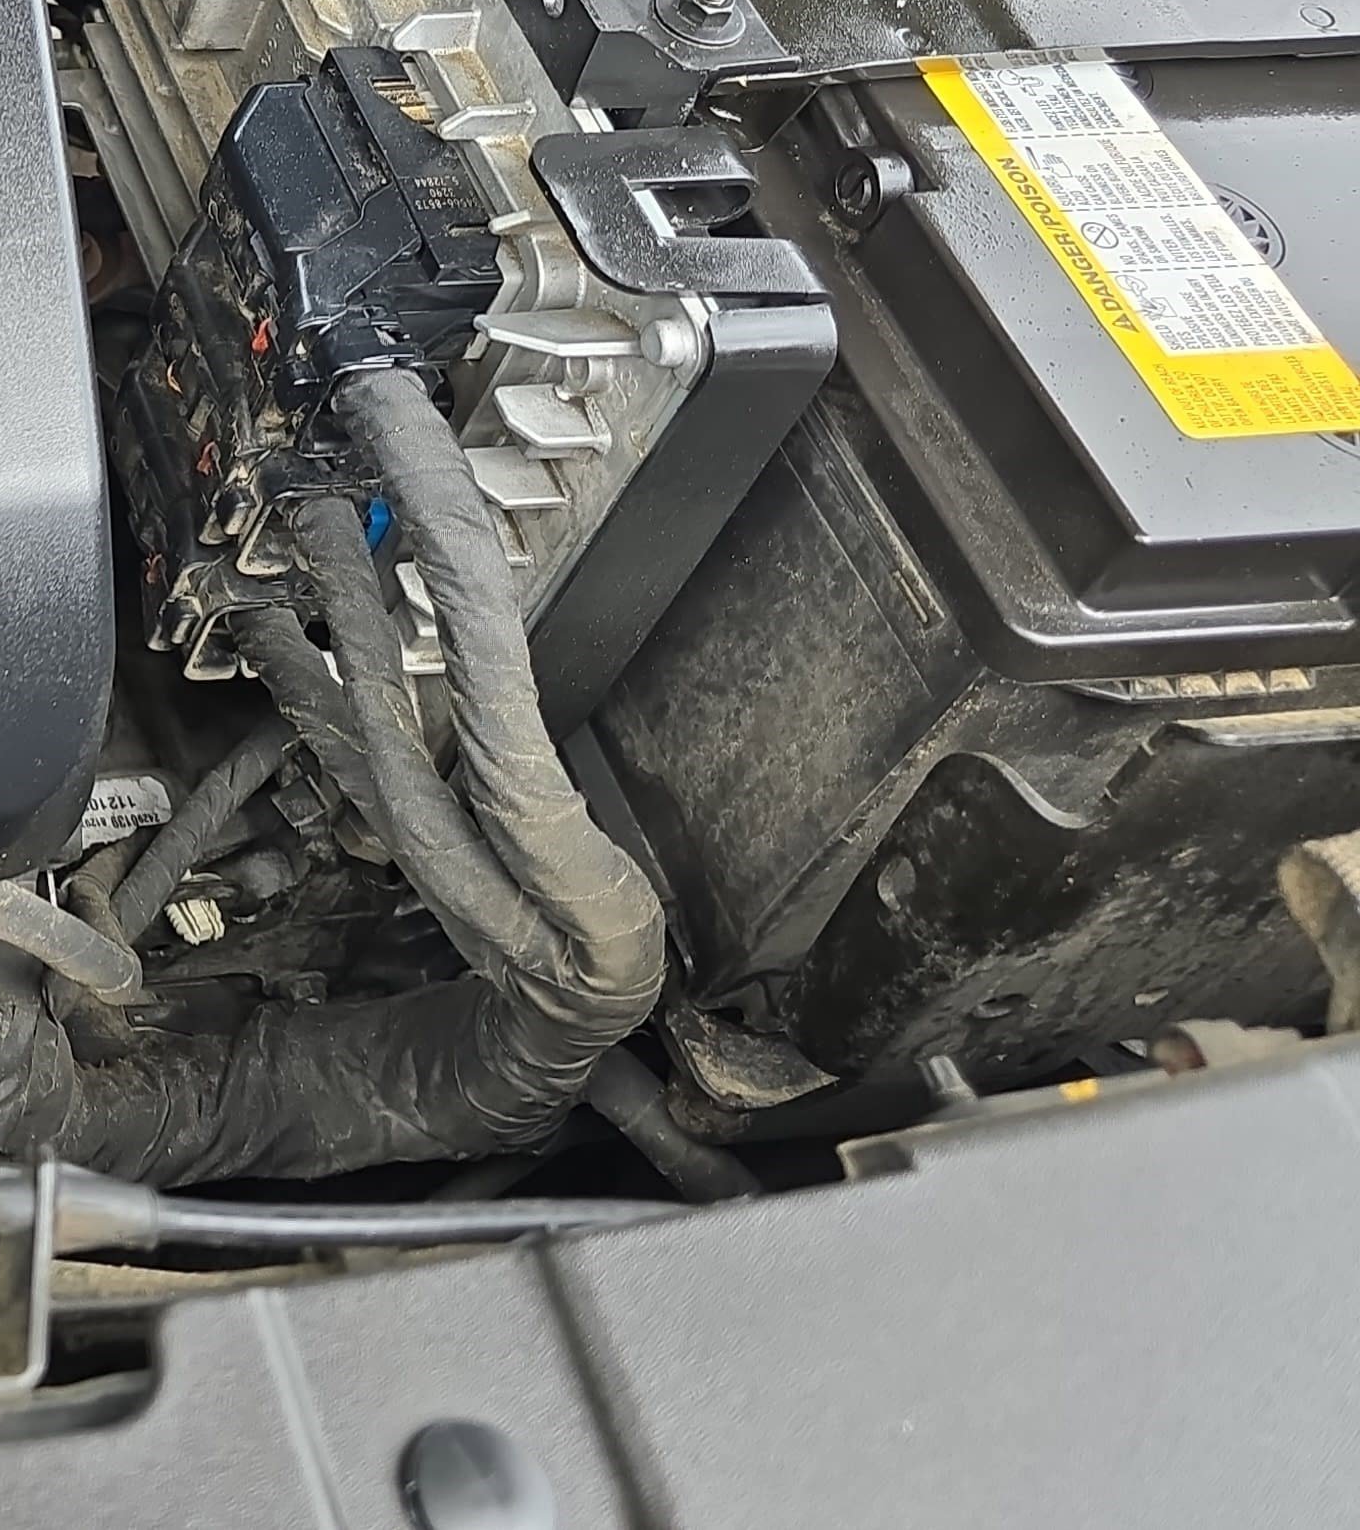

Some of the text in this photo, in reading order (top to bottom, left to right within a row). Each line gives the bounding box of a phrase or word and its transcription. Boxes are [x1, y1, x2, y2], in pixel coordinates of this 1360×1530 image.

[1076, 98, 1111, 128] CONSULTEZ
[1095, 138, 1158, 202] L'ACIDE SULFURIQUE
[1147, 161, 1166, 171] DES
[1152, 149, 1181, 170] GRAVES
[1040, 174, 1076, 206] SULFURIC
[1067, 190, 1092, 205] ACID
[1073, 175, 1107, 205] CAN CAUSE
[1081, 164, 1122, 204] BLINDNESS OR
[1096, 162, 1138, 203] SEVERE BURNS
[1151, 187, 1173, 201] PEUT
[994, 157, 1126, 310] DANGER/POISON
[1104, 213, 1133, 237] FLAMES
[1118, 255, 1137, 264] NO
[1130, 226, 1169, 263] OR SMOKING
[1156, 238, 1190, 262] ÉVITER
[1186, 251, 1206, 261] LES
[1201, 250, 1221, 261] LES
[1202, 230, 1237, 260] DE FUMER
[1177, 291, 1232, 347] GASES CAN CAUSE
[1185, 278, 1248, 346] BLINDNESS OR INJURY
[1200, 273, 1268, 346] PROTÉGEZ LES YEUX
[1227, 285, 1284, 344] LES GAZ EXPLOSIFS
[1237, 277, 1299, 344] PEUVENT BLESSER OU
[1263, 289, 1316, 343] RENDRE AVEUGLE
[1153, 324, 1185, 350] SHIELD
[1174, 331, 1201, 349] EYES
[1179, 316, 1216, 348] EXPLOSIVE
[1171, 370, 1190, 380] DO
[1189, 373, 1208, 385] NOT
[1254, 379, 1273, 390] DES
[1150, 363, 1208, 428] KEEP OUT OF REACH
[1200, 388, 1217, 396] DO
[1208, 377, 1254, 425] OPEN BATTERY
[1219, 414, 1238, 426] NOT
[1281, 415, 1297, 423] LA
